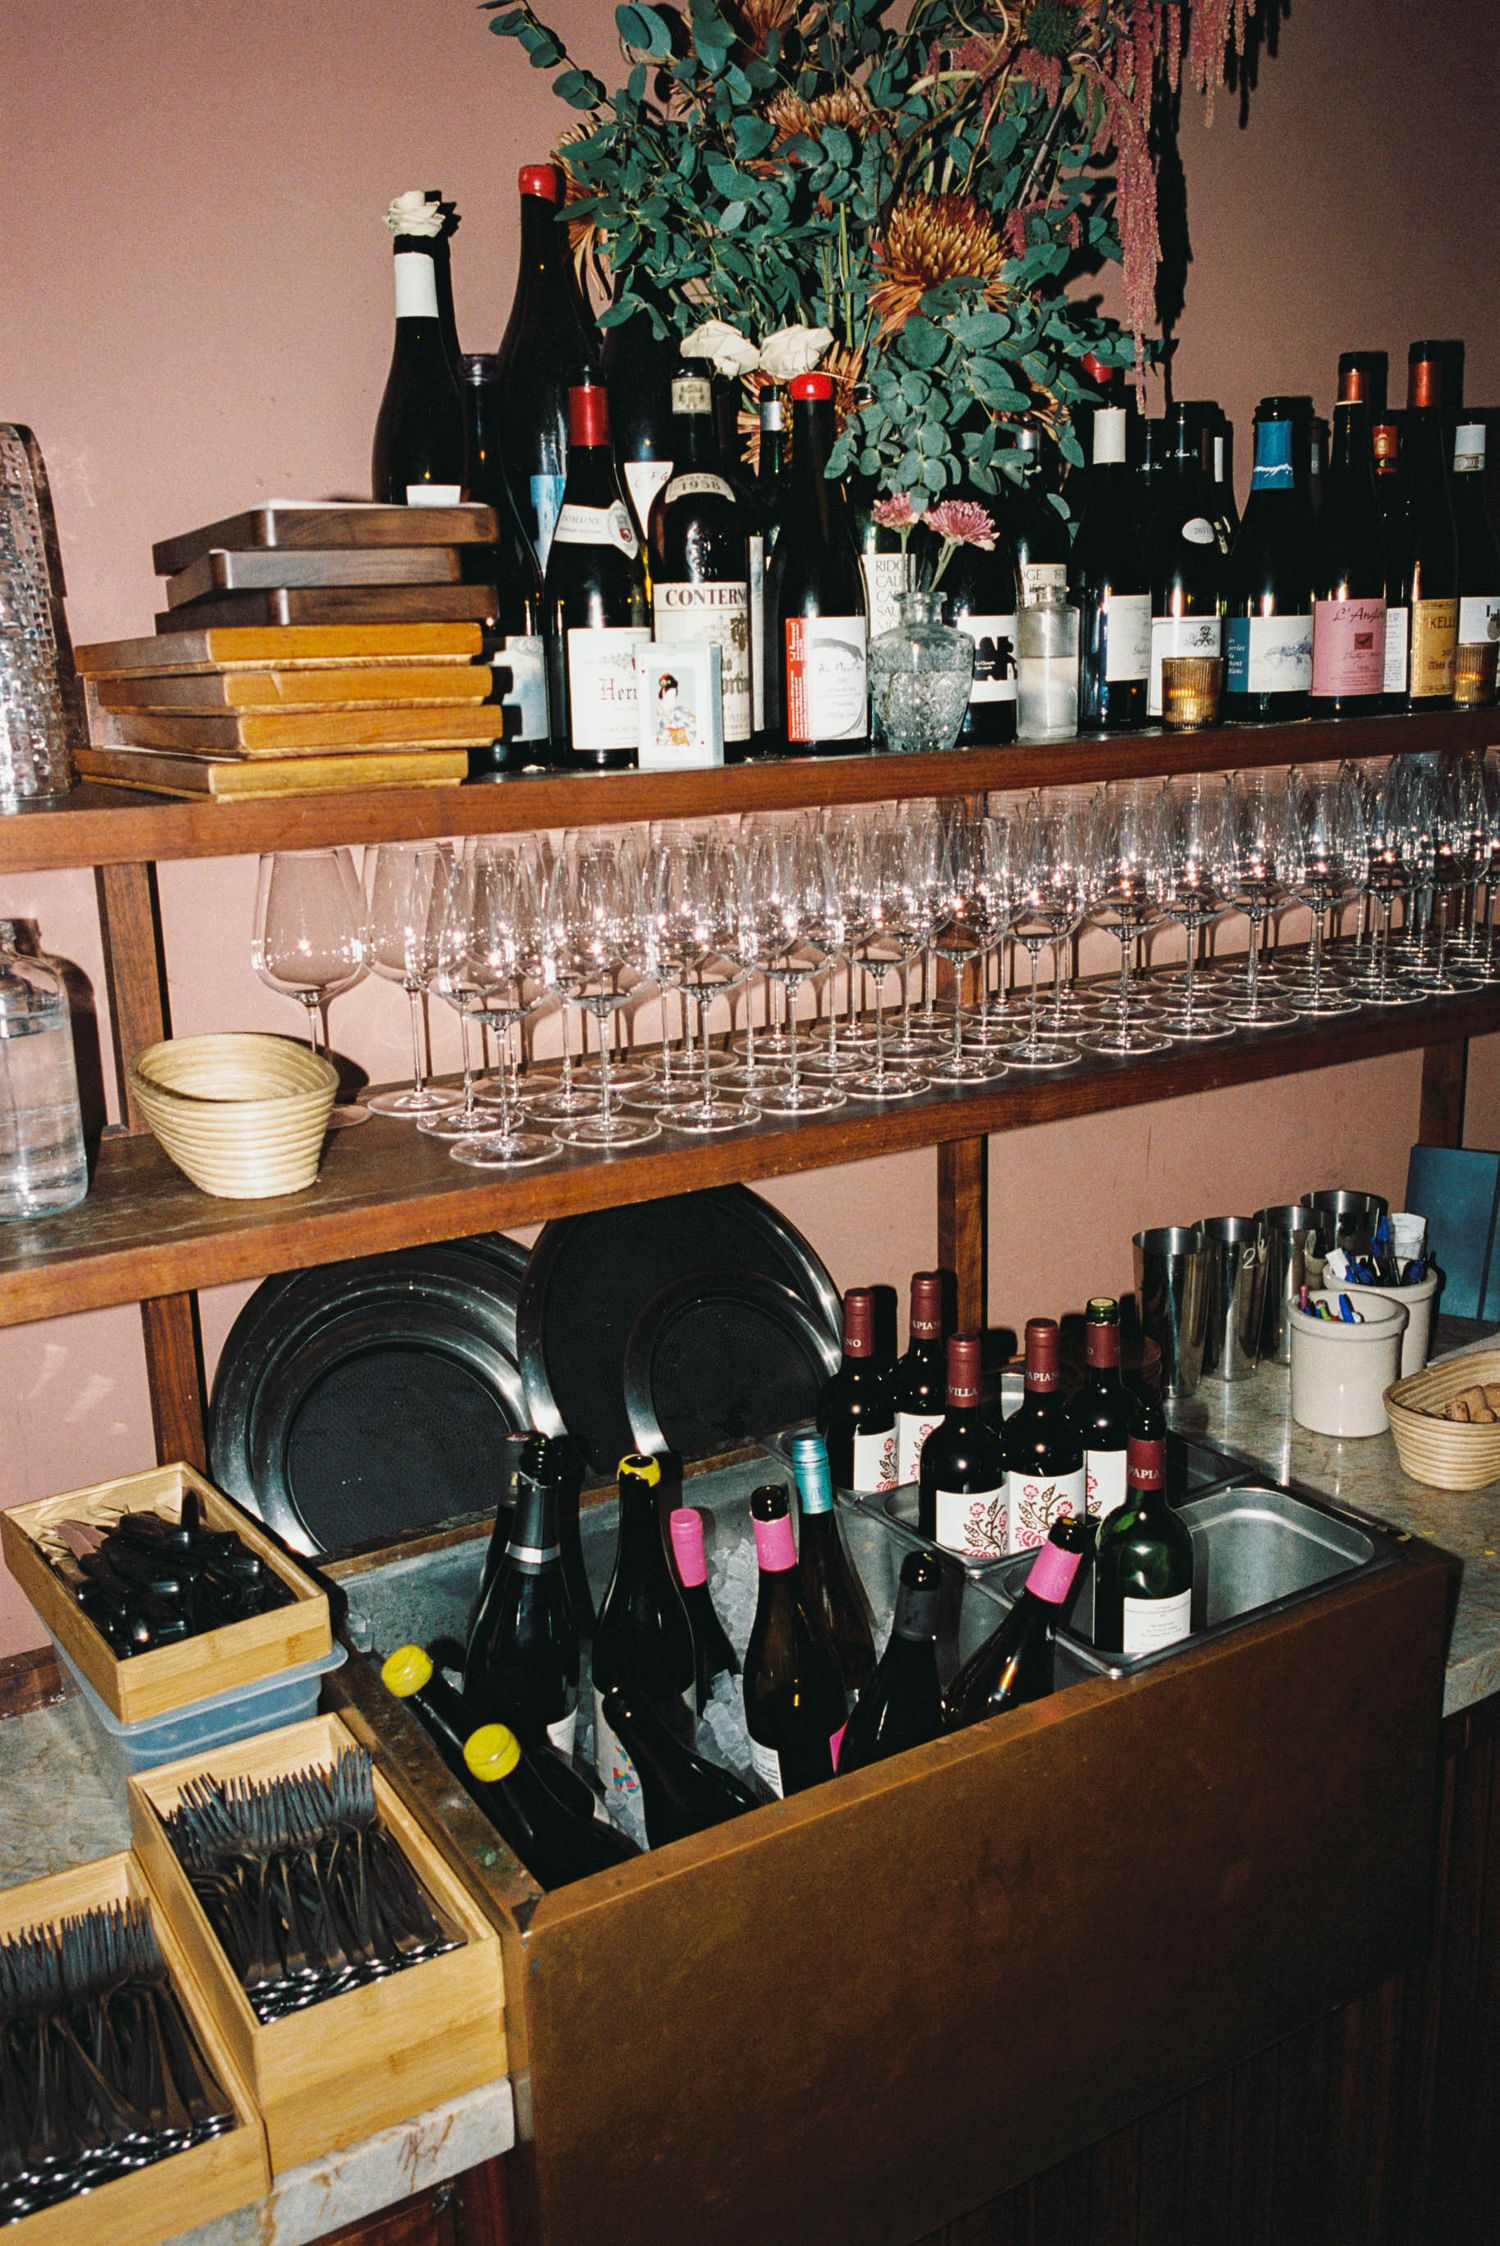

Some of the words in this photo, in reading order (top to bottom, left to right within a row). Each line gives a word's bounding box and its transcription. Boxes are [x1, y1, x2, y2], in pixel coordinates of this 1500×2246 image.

[682, 480, 721, 491] 1958
[875, 560, 907, 572] RIDG
[845, 1337, 862, 1348] NO
[948, 1385, 978, 1397] VILLA
